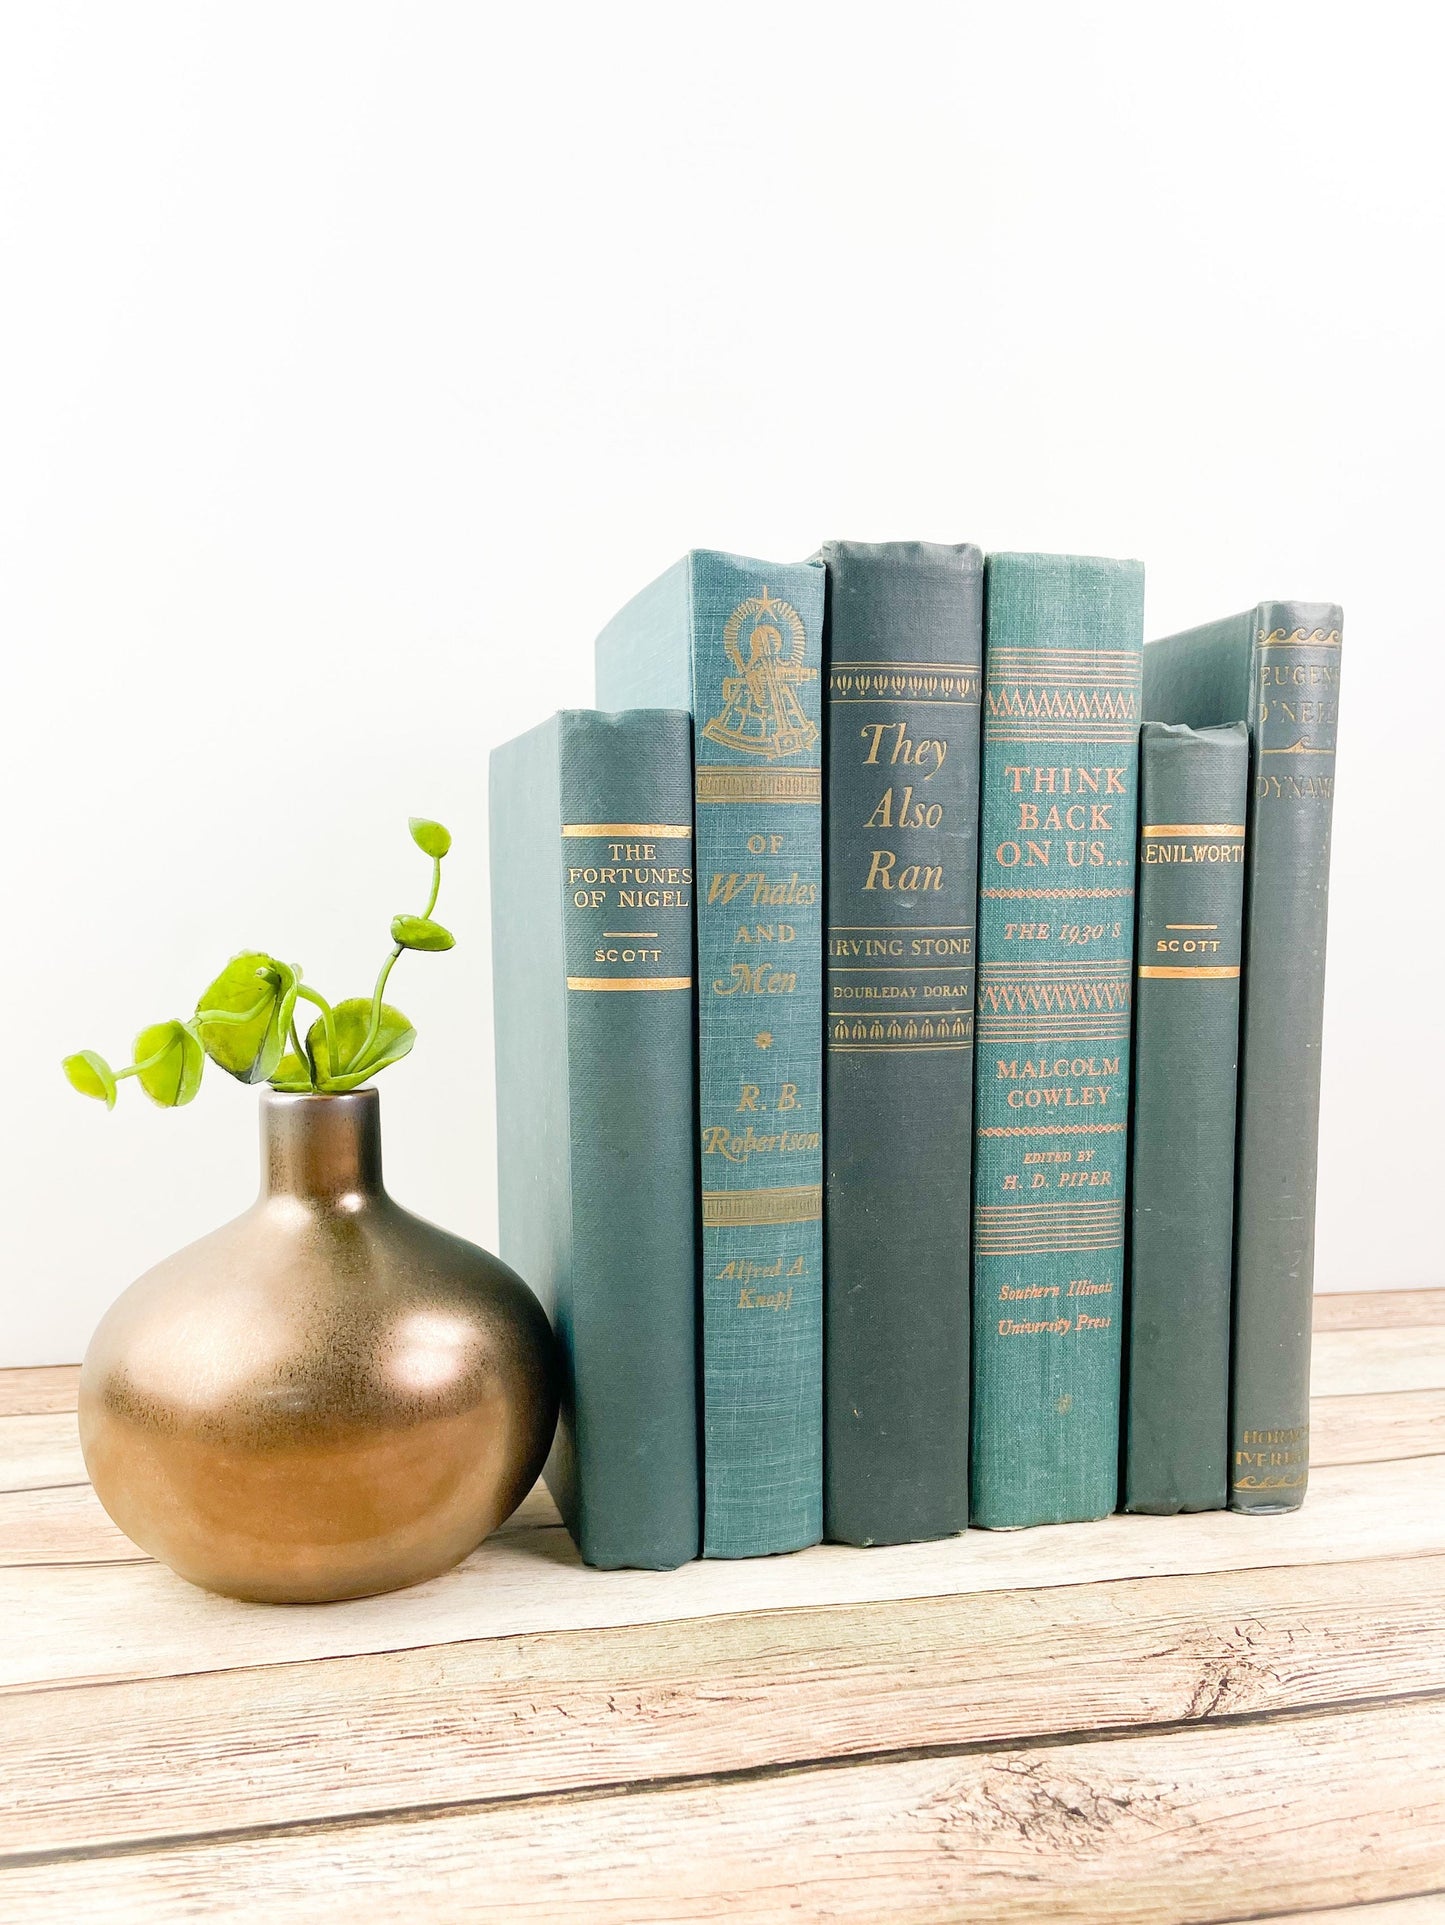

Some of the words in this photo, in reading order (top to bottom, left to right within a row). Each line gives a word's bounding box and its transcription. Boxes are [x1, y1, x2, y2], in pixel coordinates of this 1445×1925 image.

[860, 723, 947, 780] They
[1005, 766, 1128, 793] THINK
[1256, 776, 1334, 798] DYNAM
[863, 787, 943, 828] Also
[1018, 803, 1113, 830] BACK
[608, 844, 656, 860] THE
[747, 834, 784, 854] OF
[996, 841, 1052, 867] ON
[1066, 841, 1128, 867] US...
[568, 868, 692, 884] FORTUNES
[862, 850, 944, 890] Ran
[574, 891, 606, 908] OF
[619, 891, 689, 907] NIGEL
[707, 872, 817, 906] Whales
[734, 923, 796, 944] AND
[1004, 923, 1050, 940] THE
[594, 950, 662, 961] SCOTT
[828, 939, 903, 956] IRVING
[911, 938, 972, 955] STONE
[1156, 940, 1220, 953] SCOTT
[714, 963, 797, 995] Men
[833, 986, 917, 998] DOUBLEDAY
[924, 985, 968, 997] DORAN
[997, 1057, 1120, 1079] MALCOLM
[736, 1084, 767, 1111] R.
[778, 1082, 802, 1111] B.
[1007, 1087, 1112, 1108] COWLEY
[703, 1126, 820, 1163] Robertson
[1023, 1152, 1072, 1164] EDITED
[1077, 1150, 1095, 1162] BY
[1003, 1175, 1023, 1190] H.
[1031, 1173, 1049, 1188] D.
[1059, 1171, 1111, 1188] PIPER
[716, 1256, 782, 1285] Alfred
[786, 1256, 809, 1276] A.
[737, 1287, 793, 1312] Knopf
[999, 1283, 1060, 1300] Southern
[1067, 1279, 1112, 1296] Illinois
[998, 1316, 1071, 1336] University
[1075, 1313, 1111, 1331] Press
